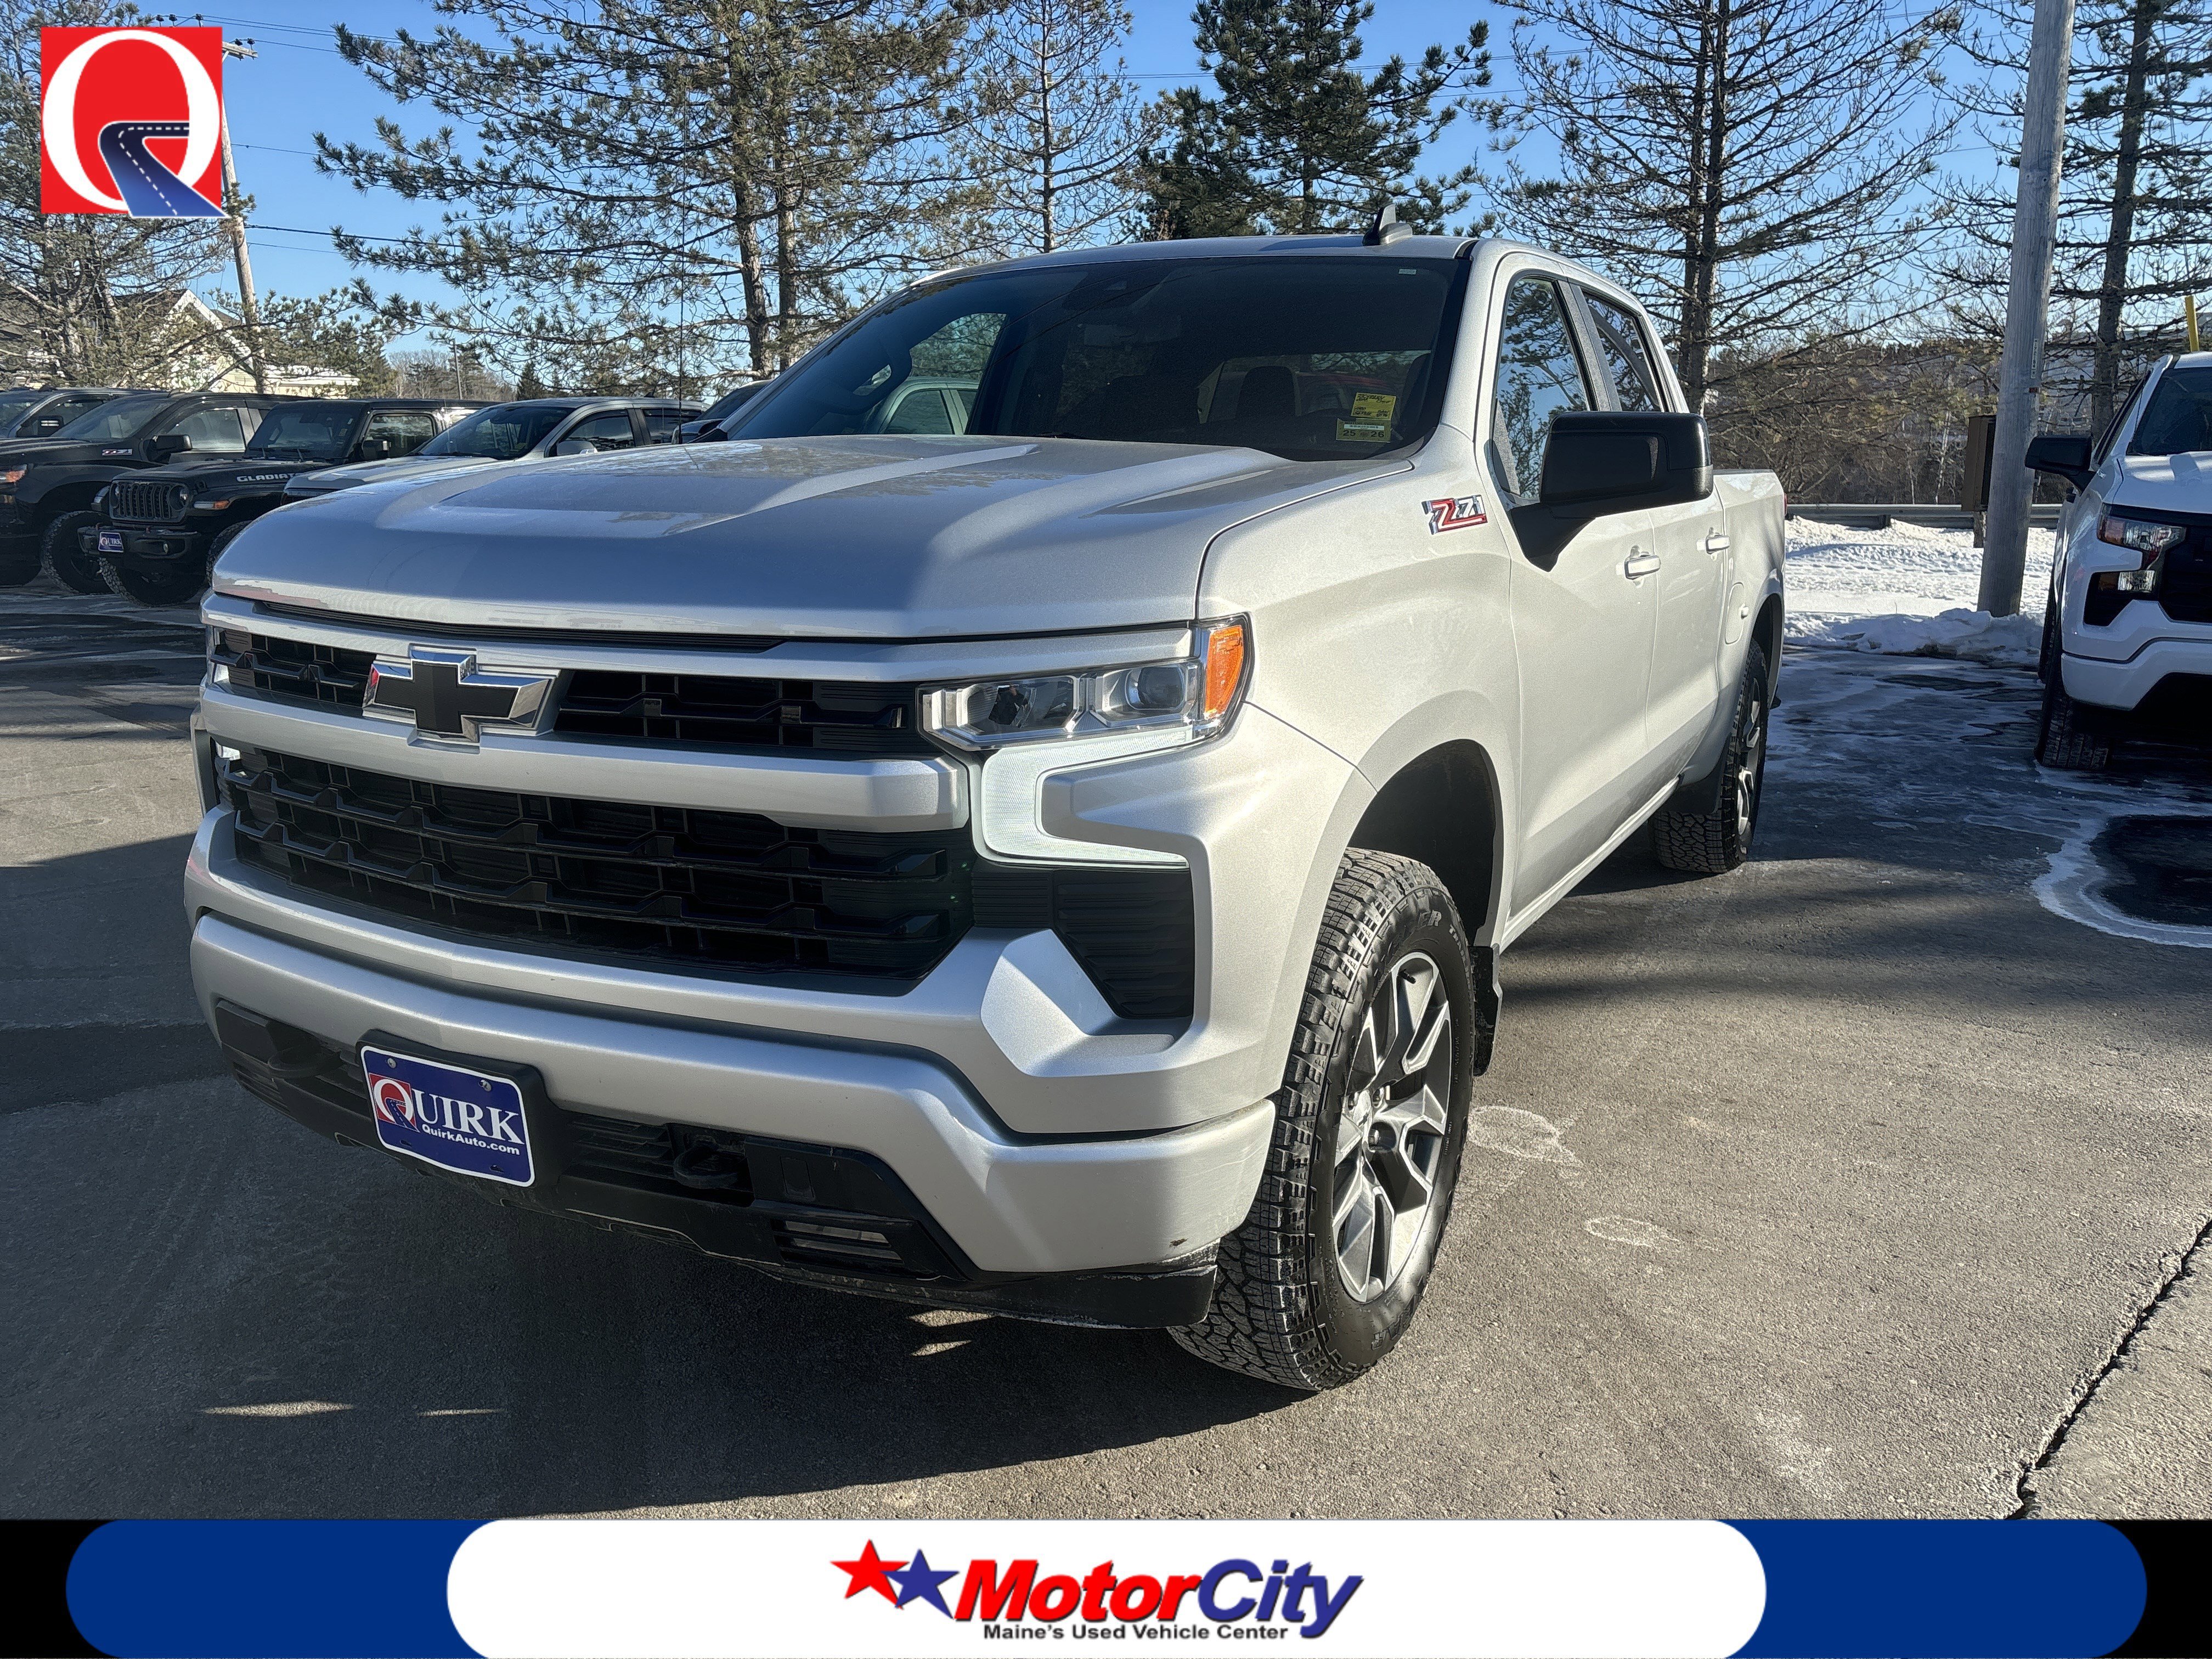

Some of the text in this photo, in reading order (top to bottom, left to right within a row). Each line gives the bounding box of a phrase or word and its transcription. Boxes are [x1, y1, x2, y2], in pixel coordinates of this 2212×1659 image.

[236, 473, 295, 482] GLADIAT
[1421, 494, 1488, 535] Z71
[373, 1079, 524, 1144] QUIRK
[422, 1124, 520, 1155] QuirkAuto.com
